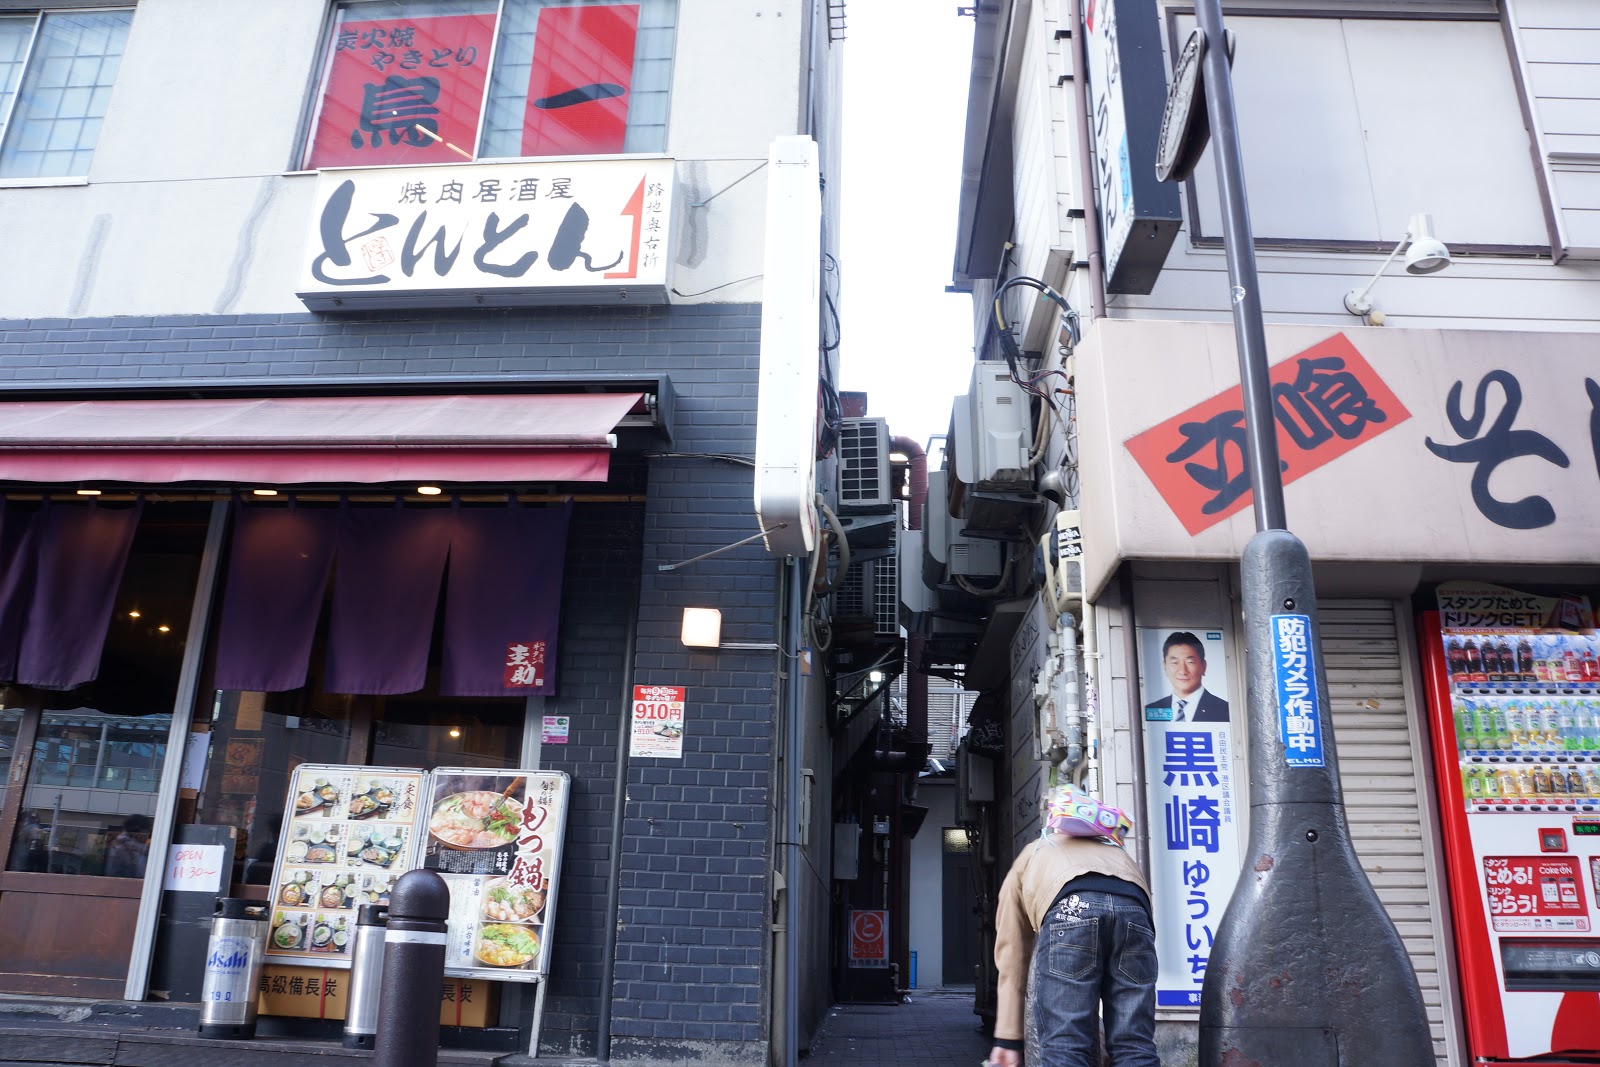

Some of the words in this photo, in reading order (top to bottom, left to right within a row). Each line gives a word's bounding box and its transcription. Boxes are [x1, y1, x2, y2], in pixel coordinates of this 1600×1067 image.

[336, 27, 416, 52] 炭火焼
[372, 46, 478, 71] やきとり
[397, 177, 576, 204] 焼肉居酒屋
[311, 178, 625, 286] とんとん
[642, 183, 666, 269] 路地奥右折
[1165, 356, 1387, 515] 立喰
[1441, 597, 1541, 610] スタンプためて、
[1444, 611, 1543, 627] ドリンクGET!
[1278, 618, 1316, 752] 防犯カメラ作動中
[635, 703, 682, 720] 910円
[1218, 731, 1230, 771] 自由民主党
[175, 850, 204, 862] OPEN
[509, 797, 548, 892] もつ鍋
[208, 951, 248, 969] Asahi
[260, 975, 338, 998] 高級備長炭
